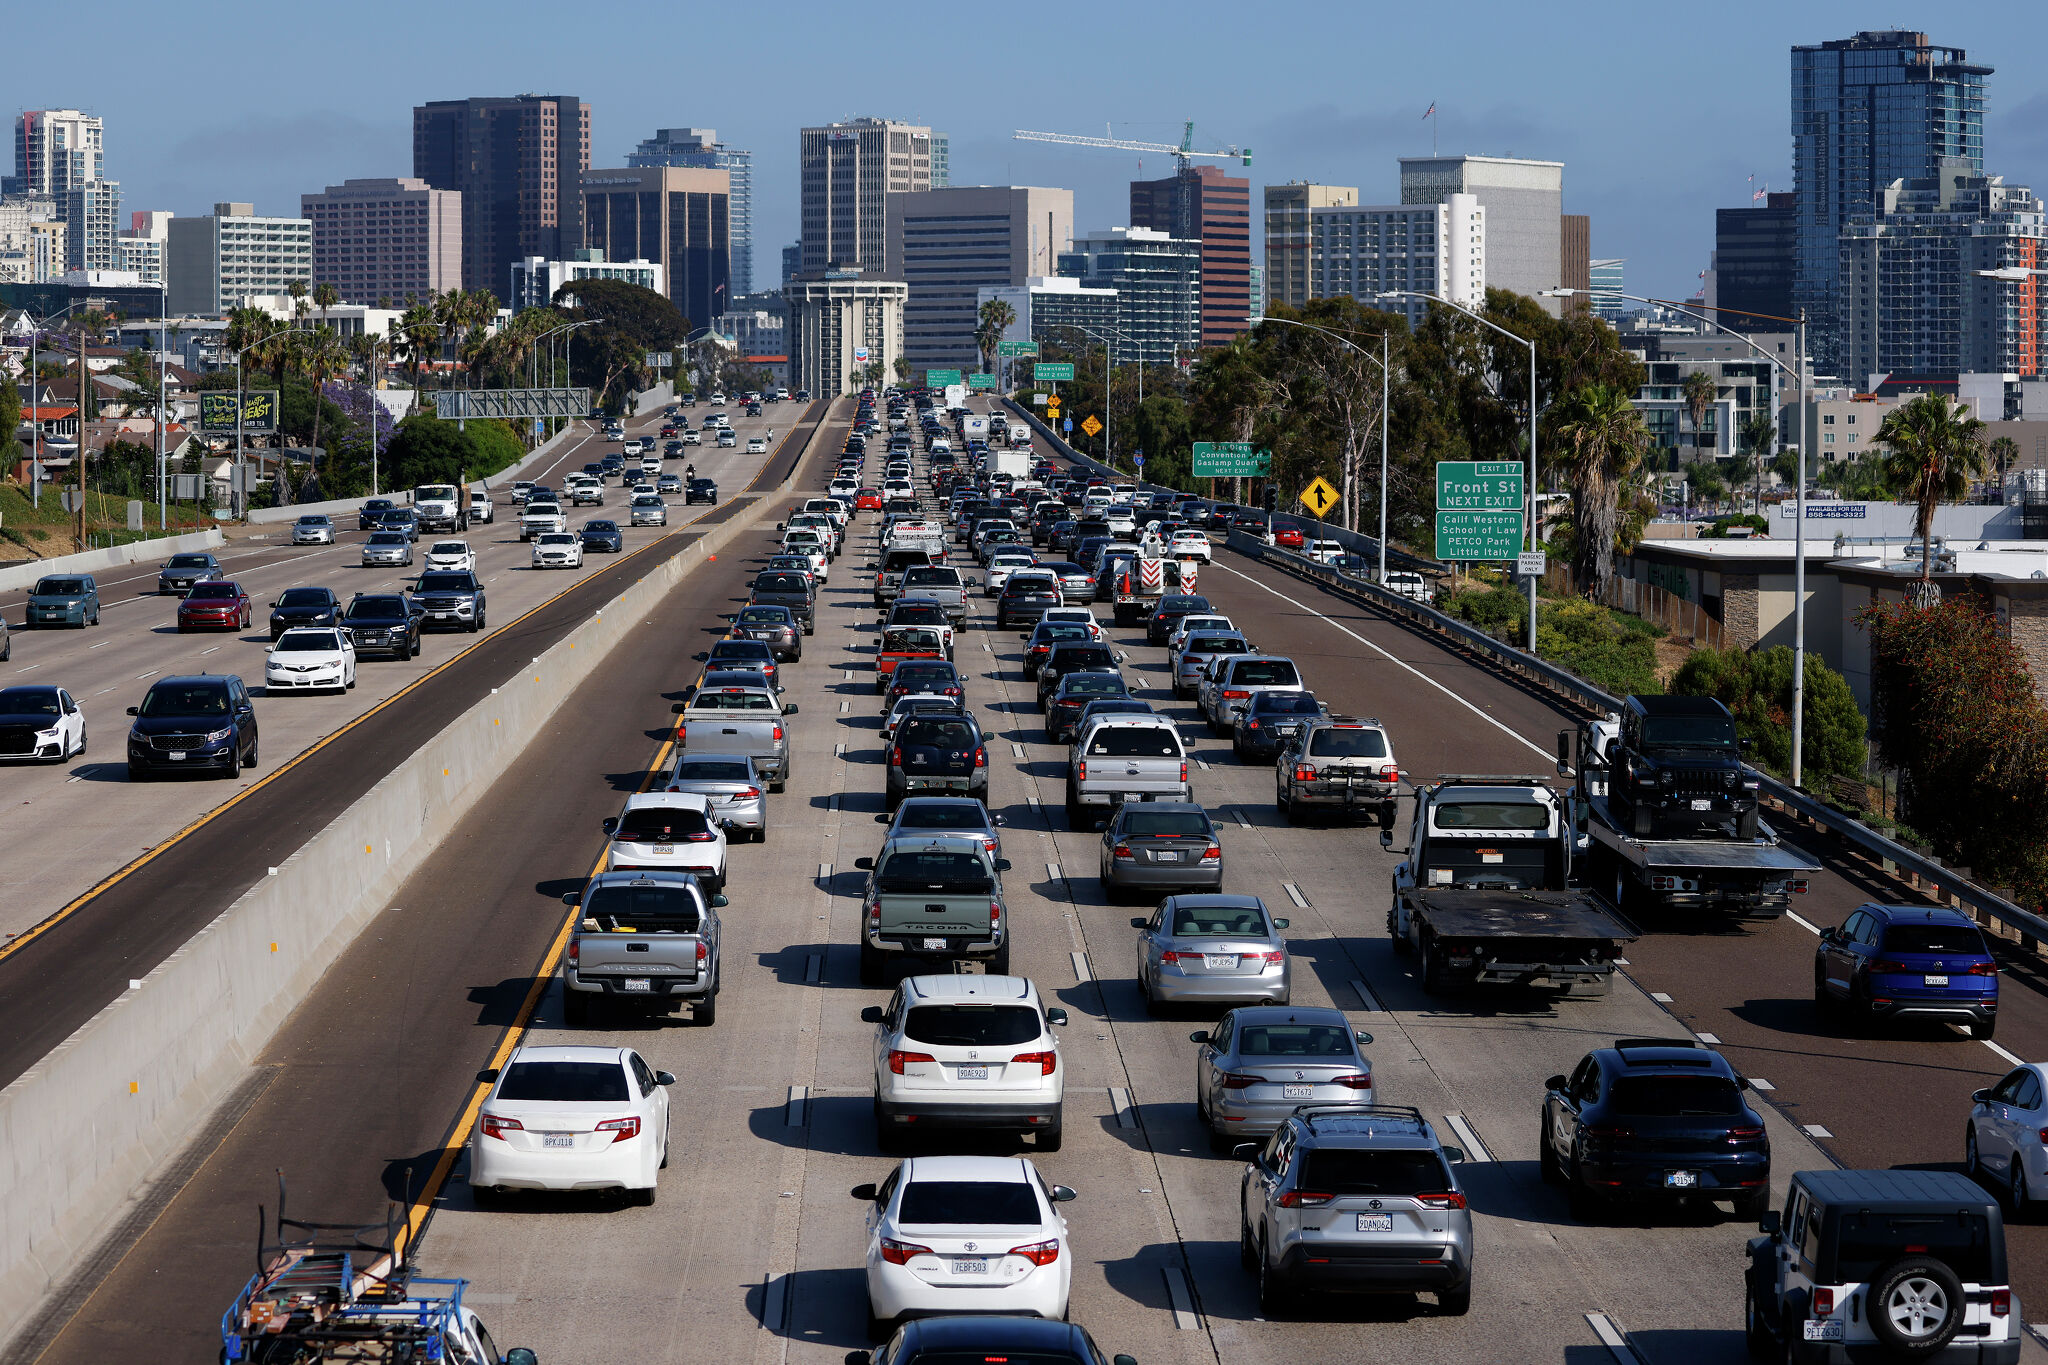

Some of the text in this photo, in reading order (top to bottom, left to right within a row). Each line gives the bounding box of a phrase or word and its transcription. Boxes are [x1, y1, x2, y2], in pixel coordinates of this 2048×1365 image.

[1197, 459, 1232, 467] Gaslamp
[1505, 464, 1517, 473] 17
[1443, 481, 1516, 493] Front St
[1446, 496, 1514, 506] NEXT EXIT
[1444, 515, 1515, 524] Calif Western
[1442, 526, 1517, 534] School of Law
[1448, 537, 1511, 546] PETCO Park
[1450, 548, 1509, 557] Little Italy
[544, 1138, 573, 1146] 8PKJ118
[955, 1262, 987, 1272] 7EBF503
